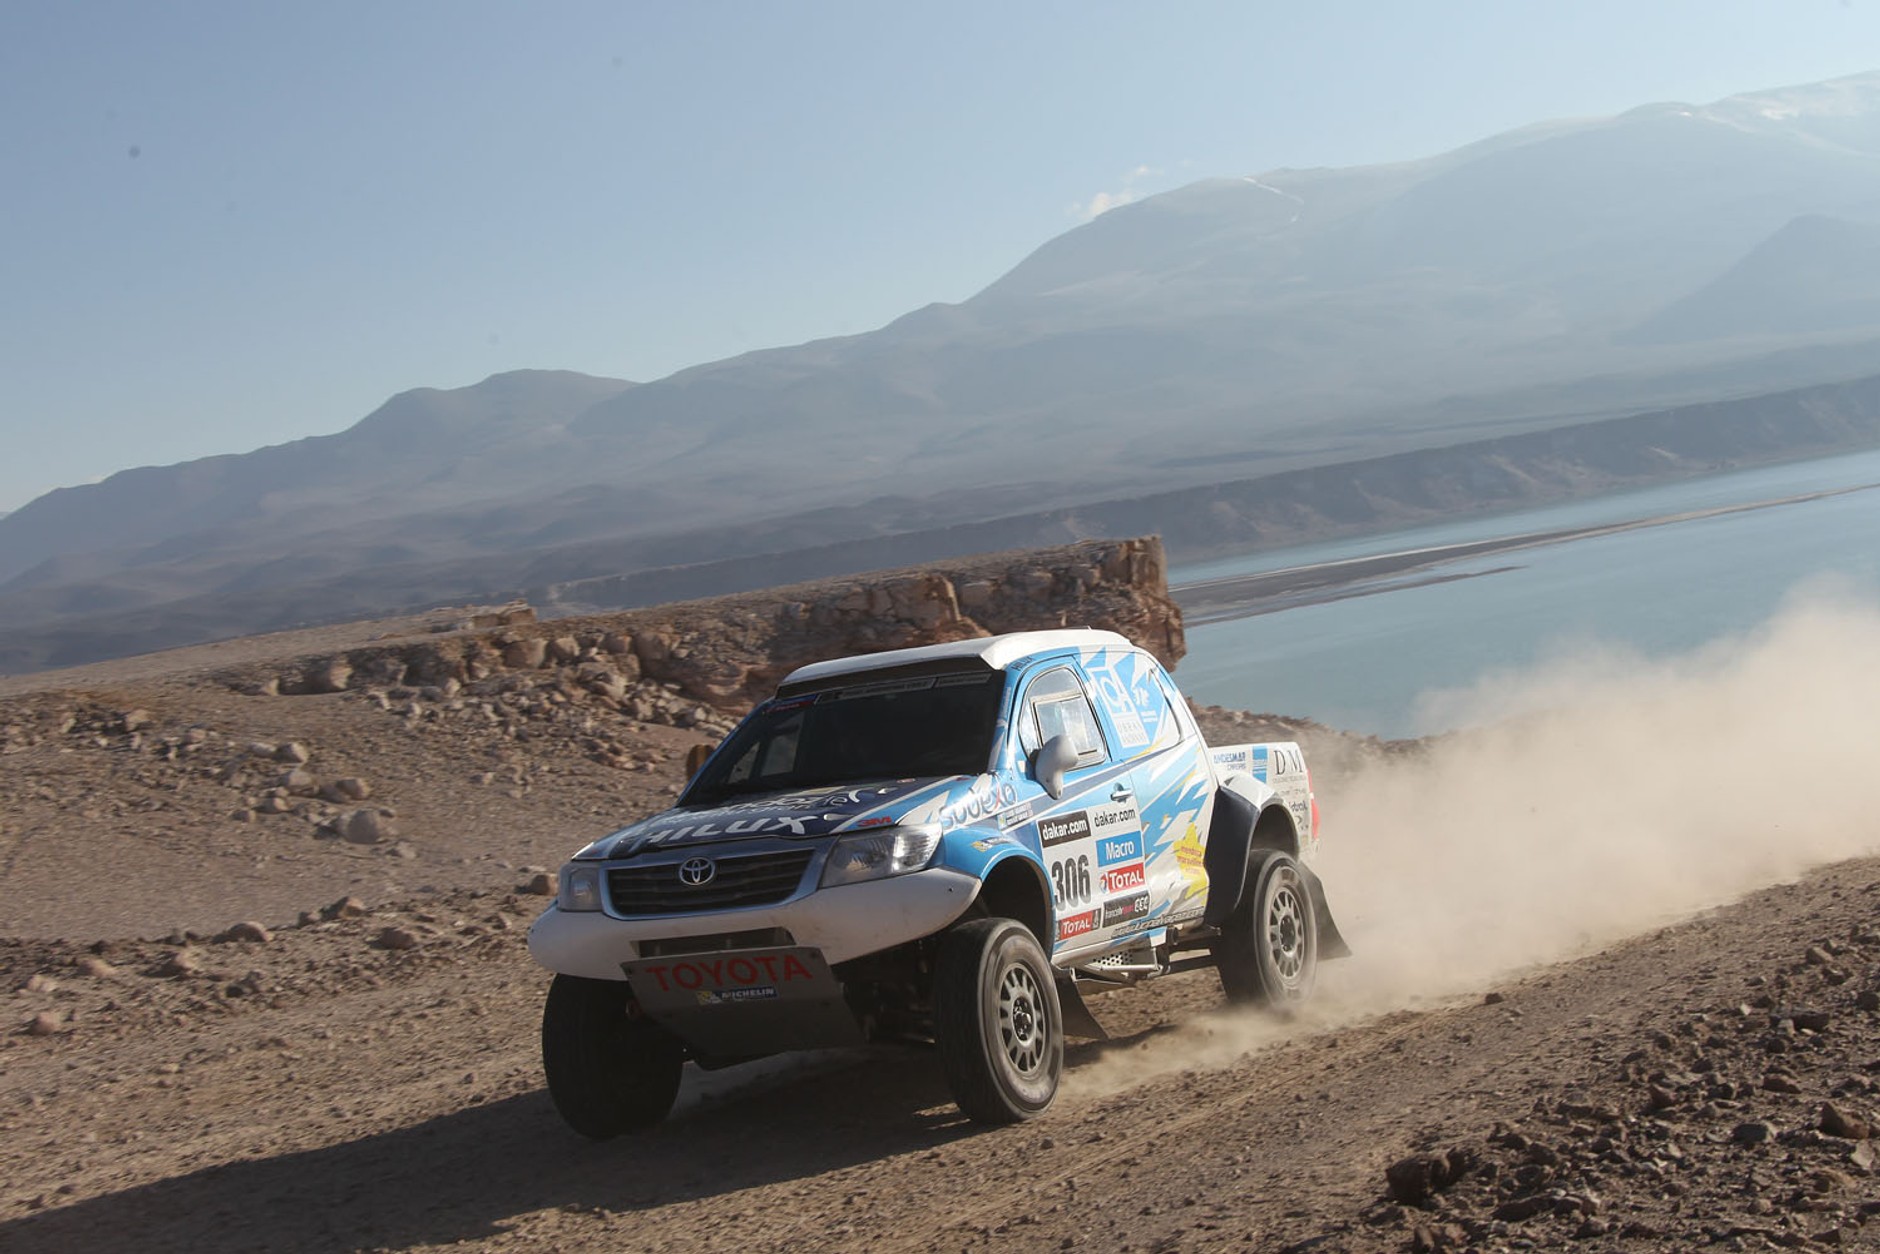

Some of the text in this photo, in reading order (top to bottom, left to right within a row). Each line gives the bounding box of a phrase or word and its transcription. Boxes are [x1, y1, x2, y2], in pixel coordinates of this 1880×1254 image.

[858, 817, 892, 827] 3M
[1094, 809, 1136, 827] dakar.com
[633, 816, 818, 847] HILUX
[1042, 819, 1088, 840] dakar.com
[1105, 841, 1135, 860] Macro
[1051, 854, 1092, 912] 306
[1109, 869, 1144, 890] TOTAL
[1062, 919, 1092, 935] TOTAL
[645, 955, 813, 992] TOYOTA
[721, 987, 776, 999] MICHELIN
